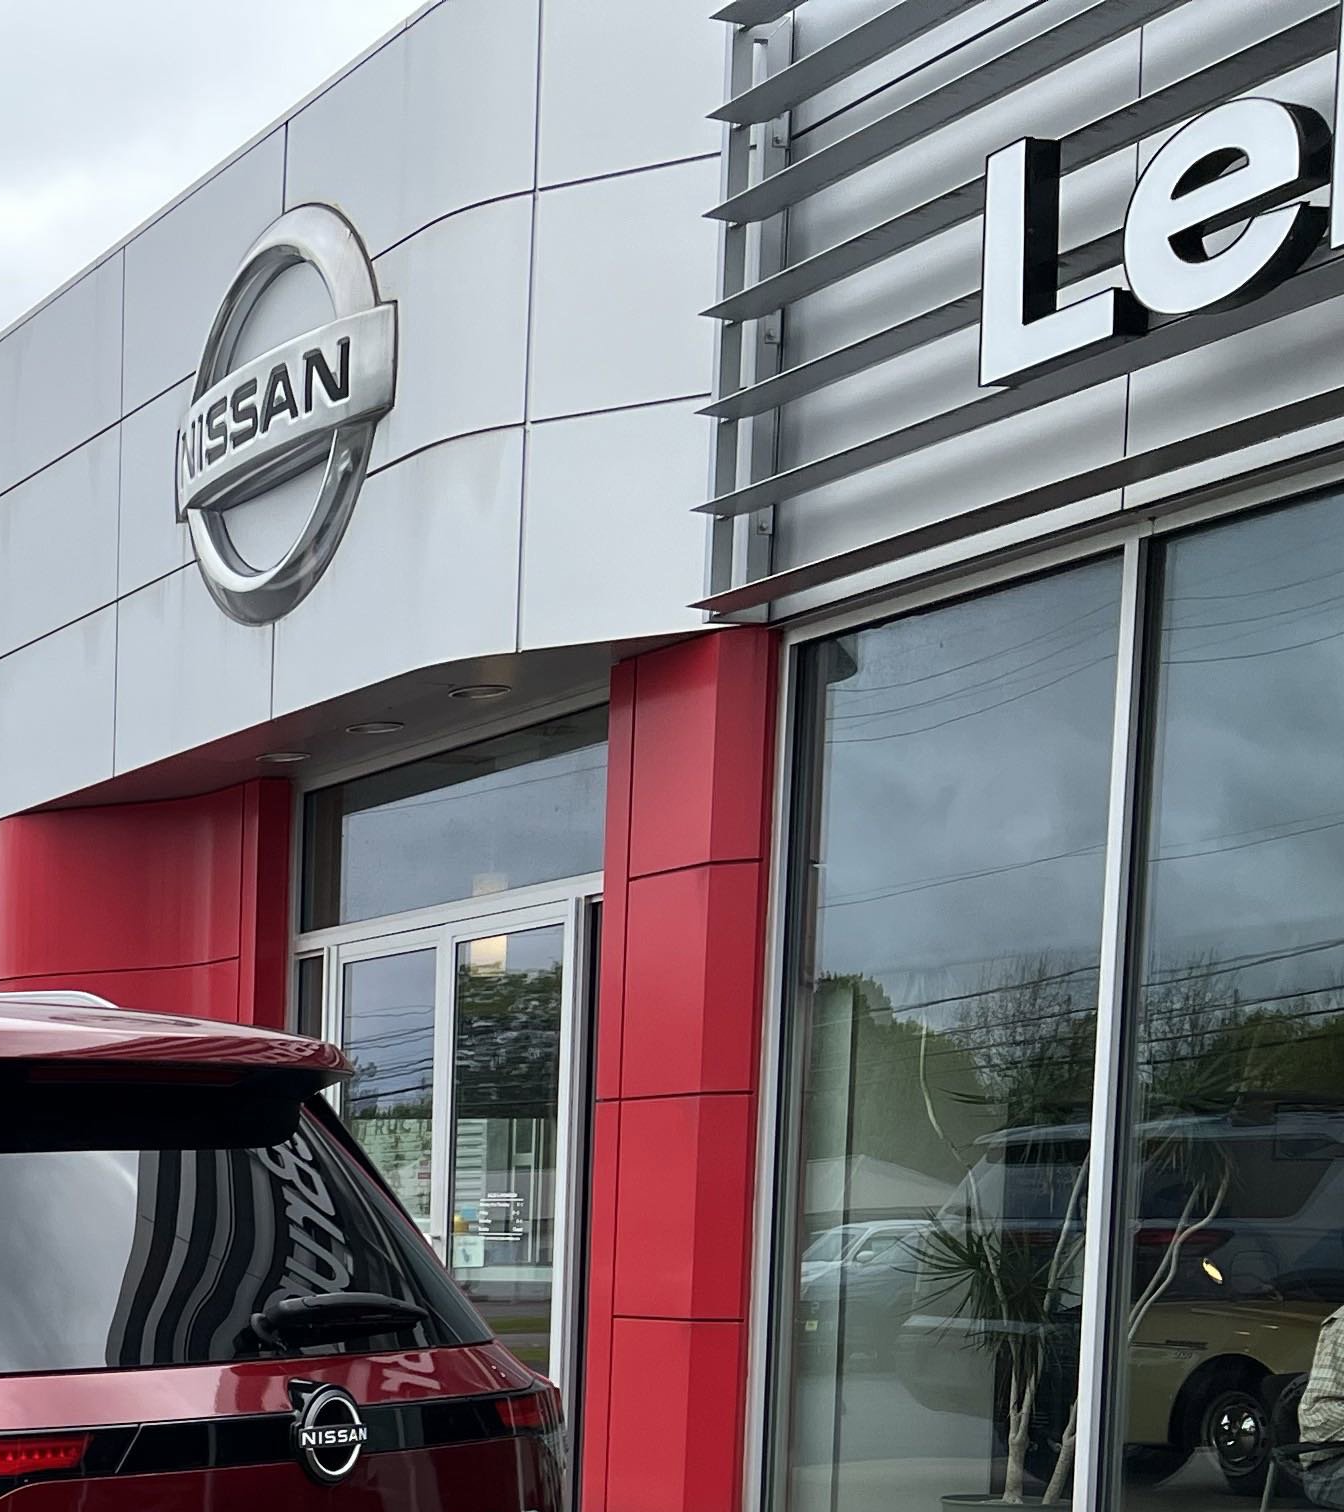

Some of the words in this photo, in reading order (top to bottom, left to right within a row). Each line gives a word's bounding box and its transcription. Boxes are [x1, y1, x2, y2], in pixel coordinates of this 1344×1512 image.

[979, 0, 1344, 388] Le
[181, 336, 350, 490] NISSAN
[302, 1427, 368, 1446] NISSAN
